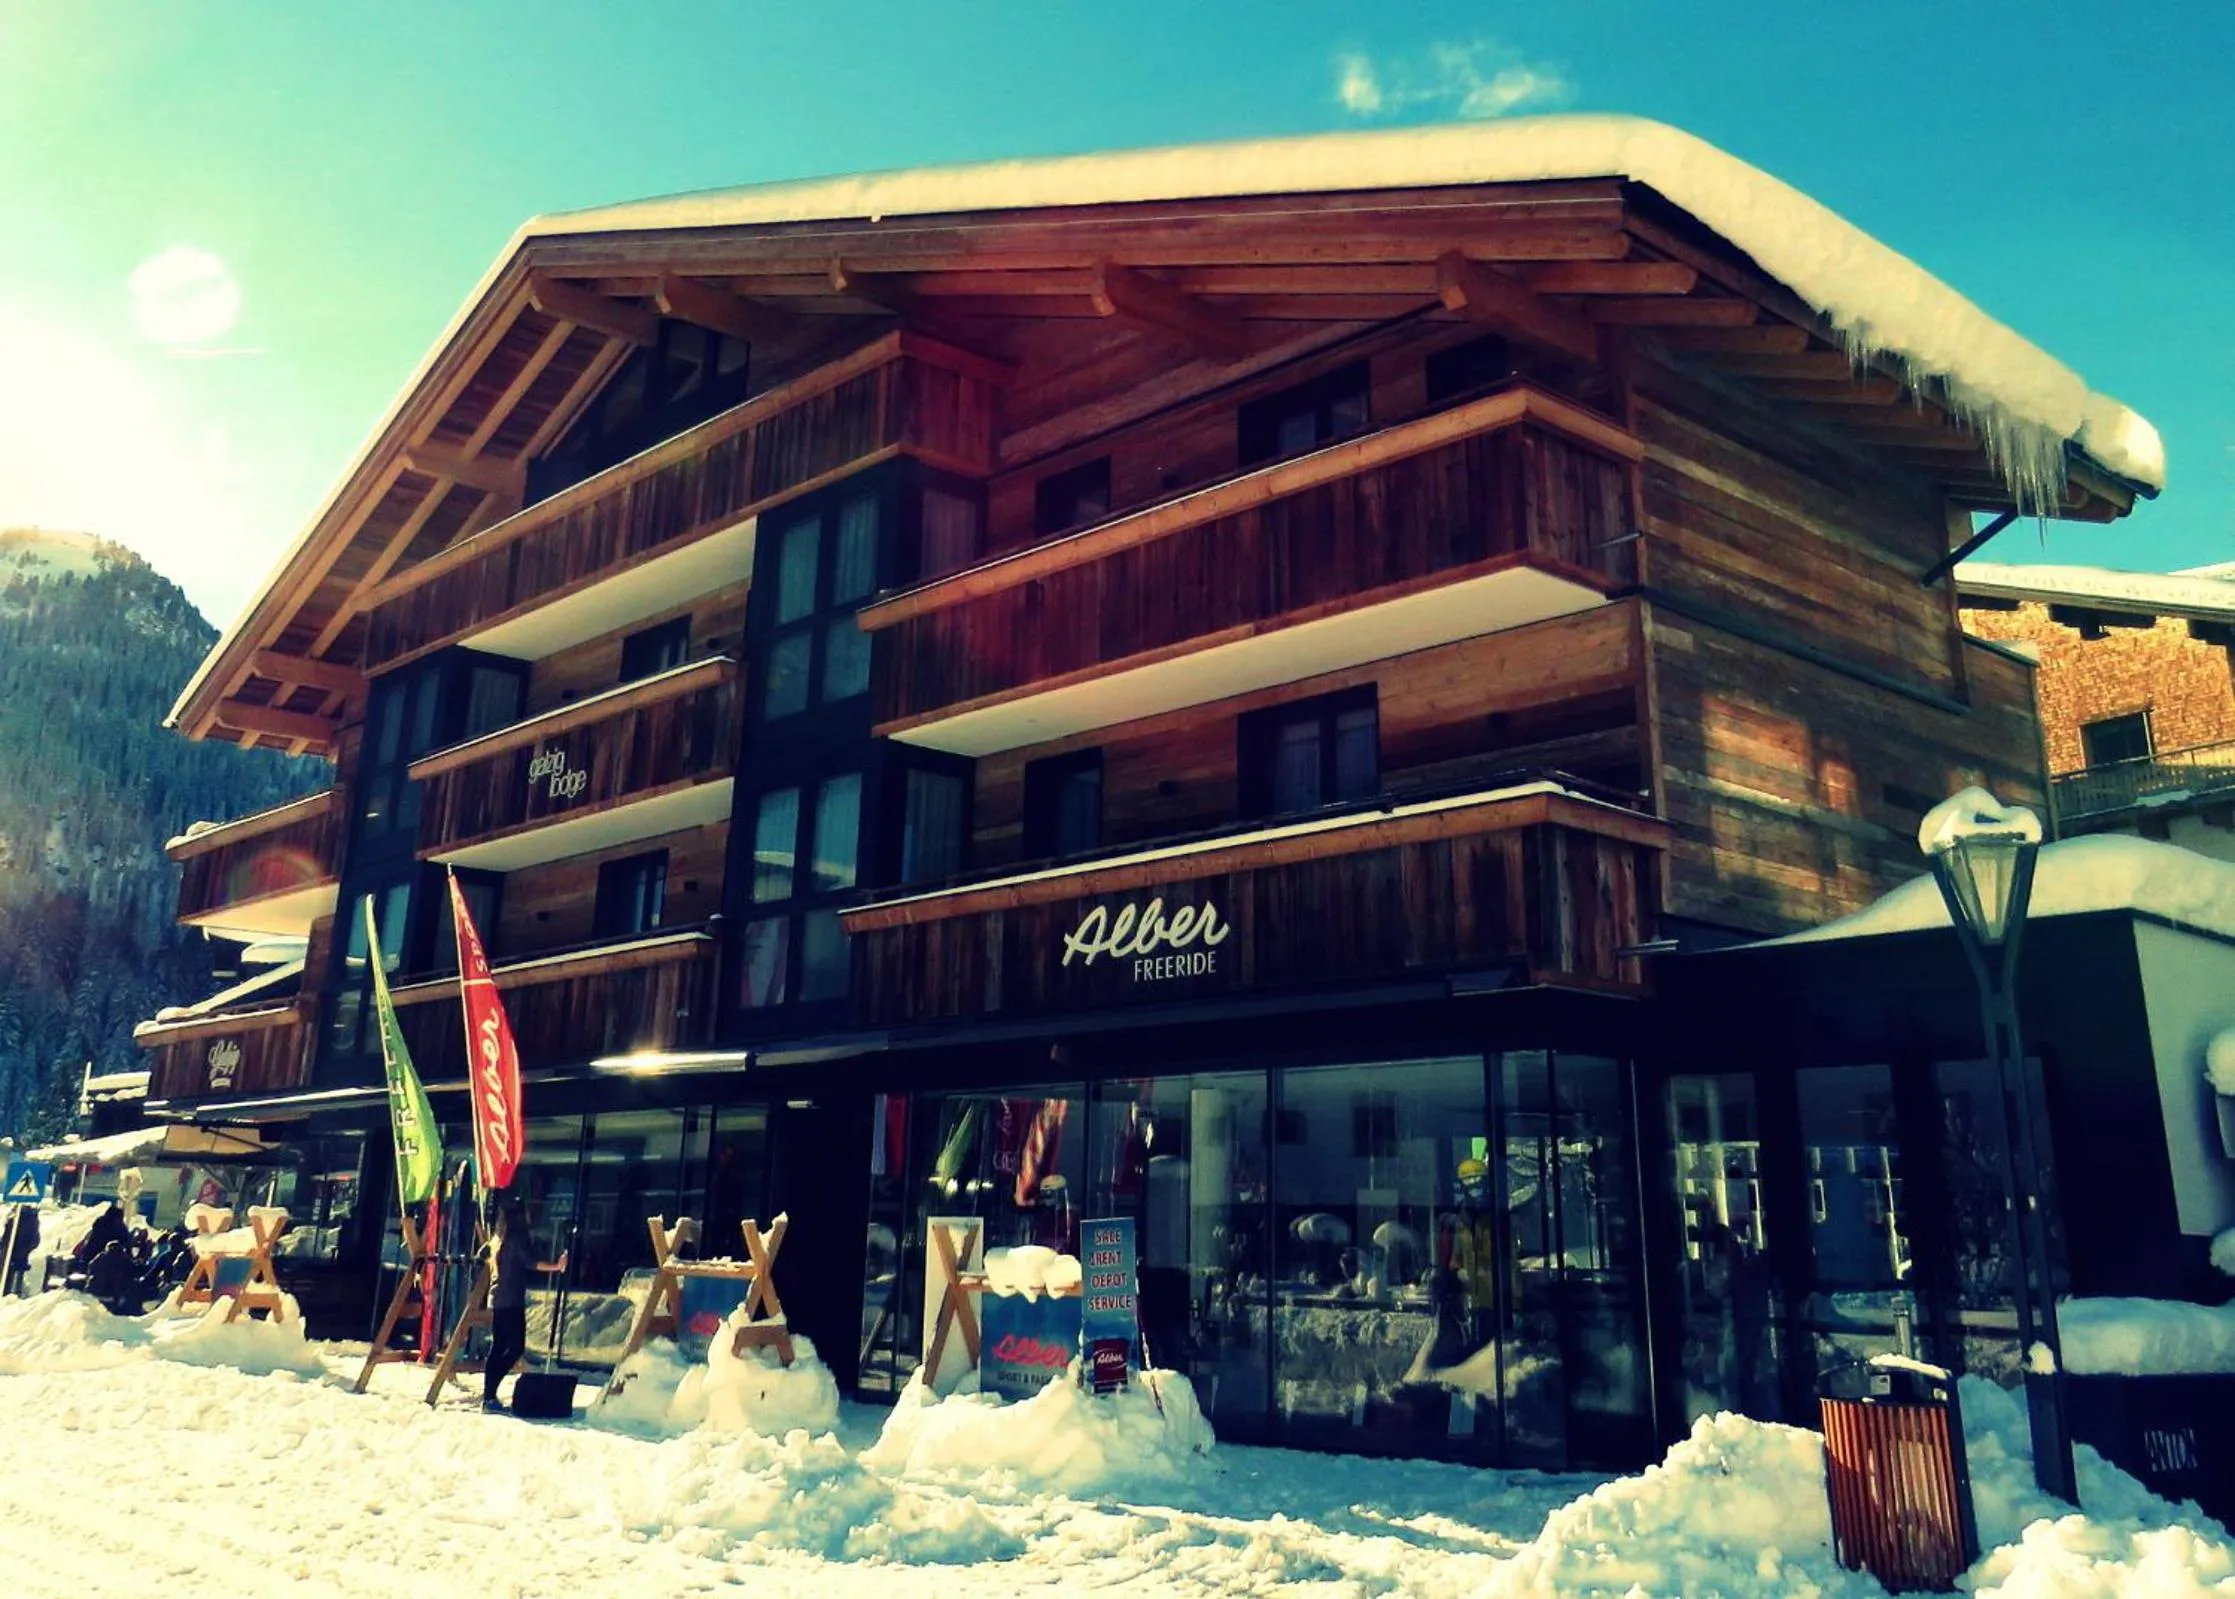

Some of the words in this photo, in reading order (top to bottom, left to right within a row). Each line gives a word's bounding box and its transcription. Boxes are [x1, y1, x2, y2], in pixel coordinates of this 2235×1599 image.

[549, 768, 587, 798] lodge
[1061, 897, 1230, 967] Alber
[1133, 951, 1217, 982] FREERIDE
[480, 1007, 513, 1164] Alber
[1094, 1229, 1122, 1244] SALE
[1090, 1272, 1127, 1289] DEPOT
[1087, 1295, 1132, 1311] SERVICE
